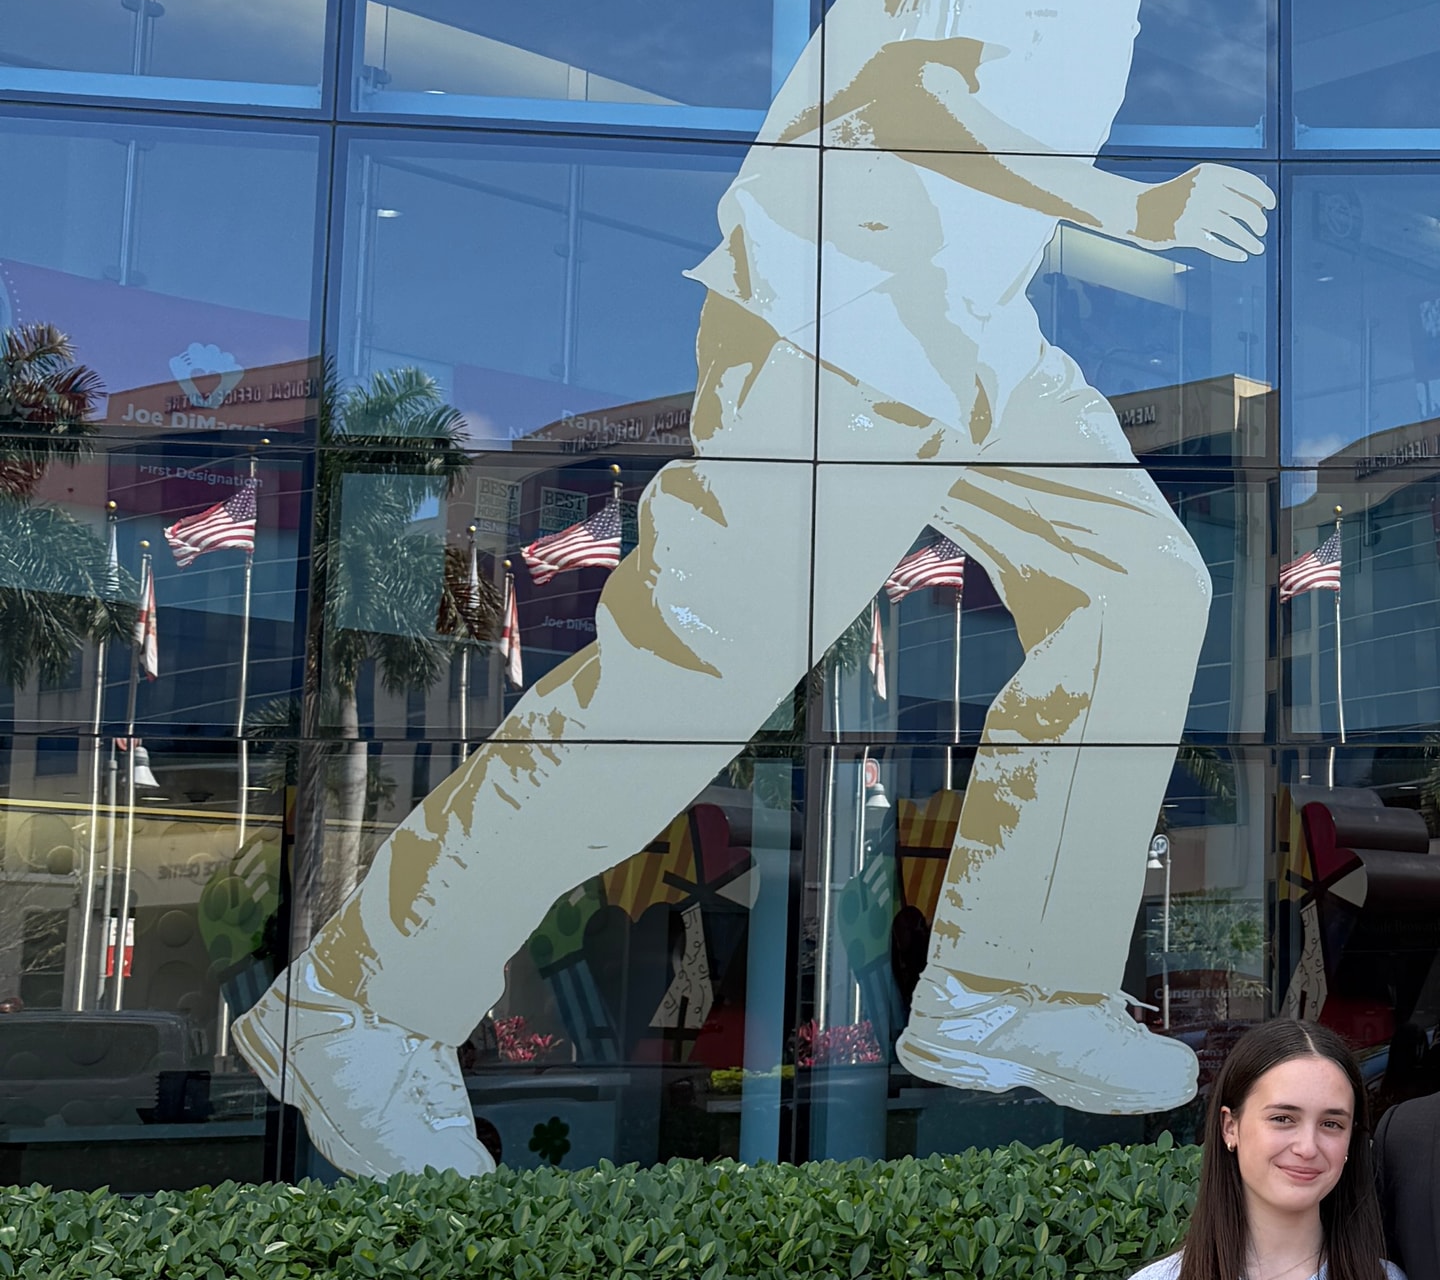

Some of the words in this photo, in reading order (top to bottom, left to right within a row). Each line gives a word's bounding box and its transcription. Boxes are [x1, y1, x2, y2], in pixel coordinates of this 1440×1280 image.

[121, 403, 164, 426] Joe
[175, 466, 263, 488] Designation
[479, 478, 519, 501] BEST
[544, 491, 585, 511] BEST
